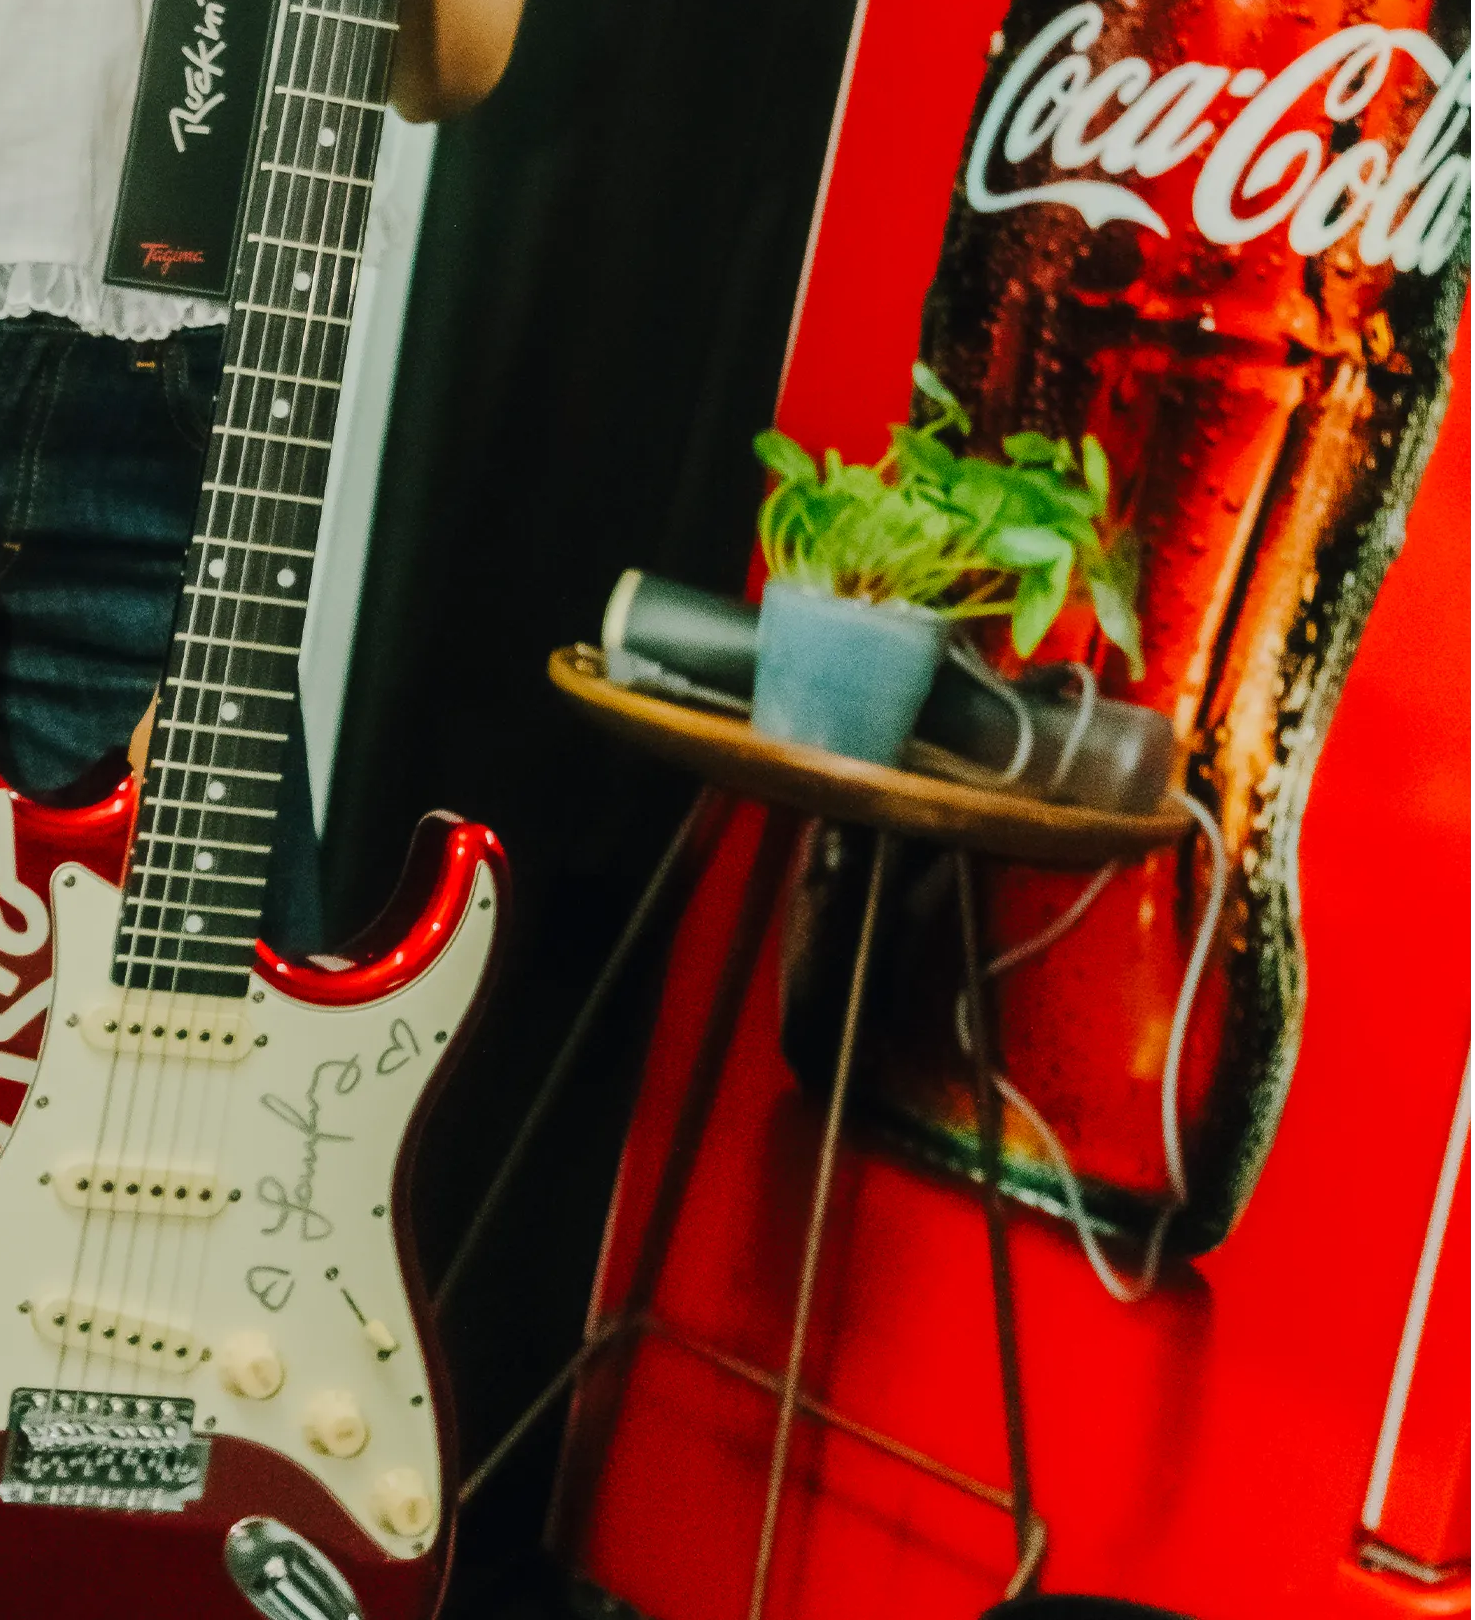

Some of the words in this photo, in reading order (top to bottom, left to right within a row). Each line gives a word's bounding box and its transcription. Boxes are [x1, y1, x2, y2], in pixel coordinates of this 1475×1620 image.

[193, 1, 226, 41] in
[169, 38, 227, 154] Rock
[965, 1, 1471, 276] Coca-Cola
